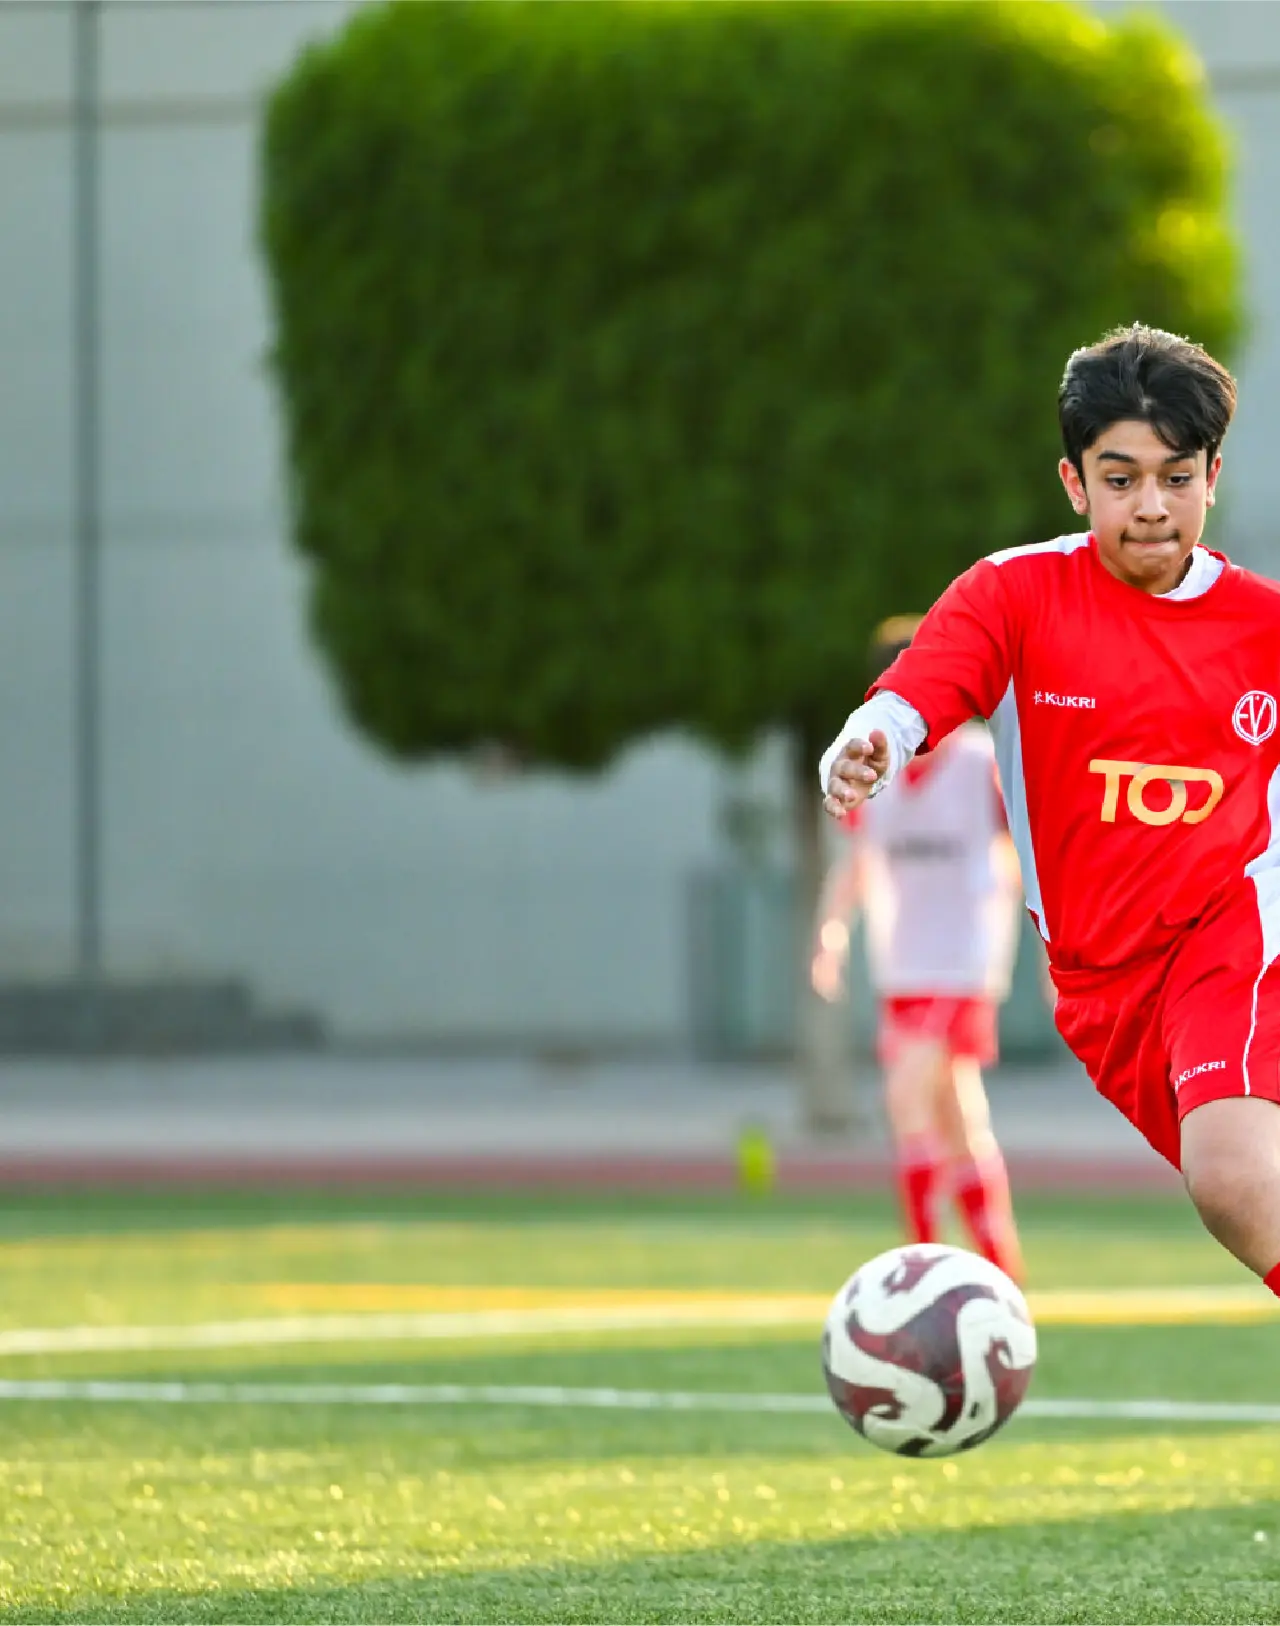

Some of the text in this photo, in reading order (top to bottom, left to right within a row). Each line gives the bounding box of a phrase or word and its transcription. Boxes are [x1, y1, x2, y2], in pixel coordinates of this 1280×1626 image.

[1045, 692, 1096, 709] KUKRI
[1088, 758, 1224, 826] TOD
[1178, 1060, 1226, 1086] KUKRI
